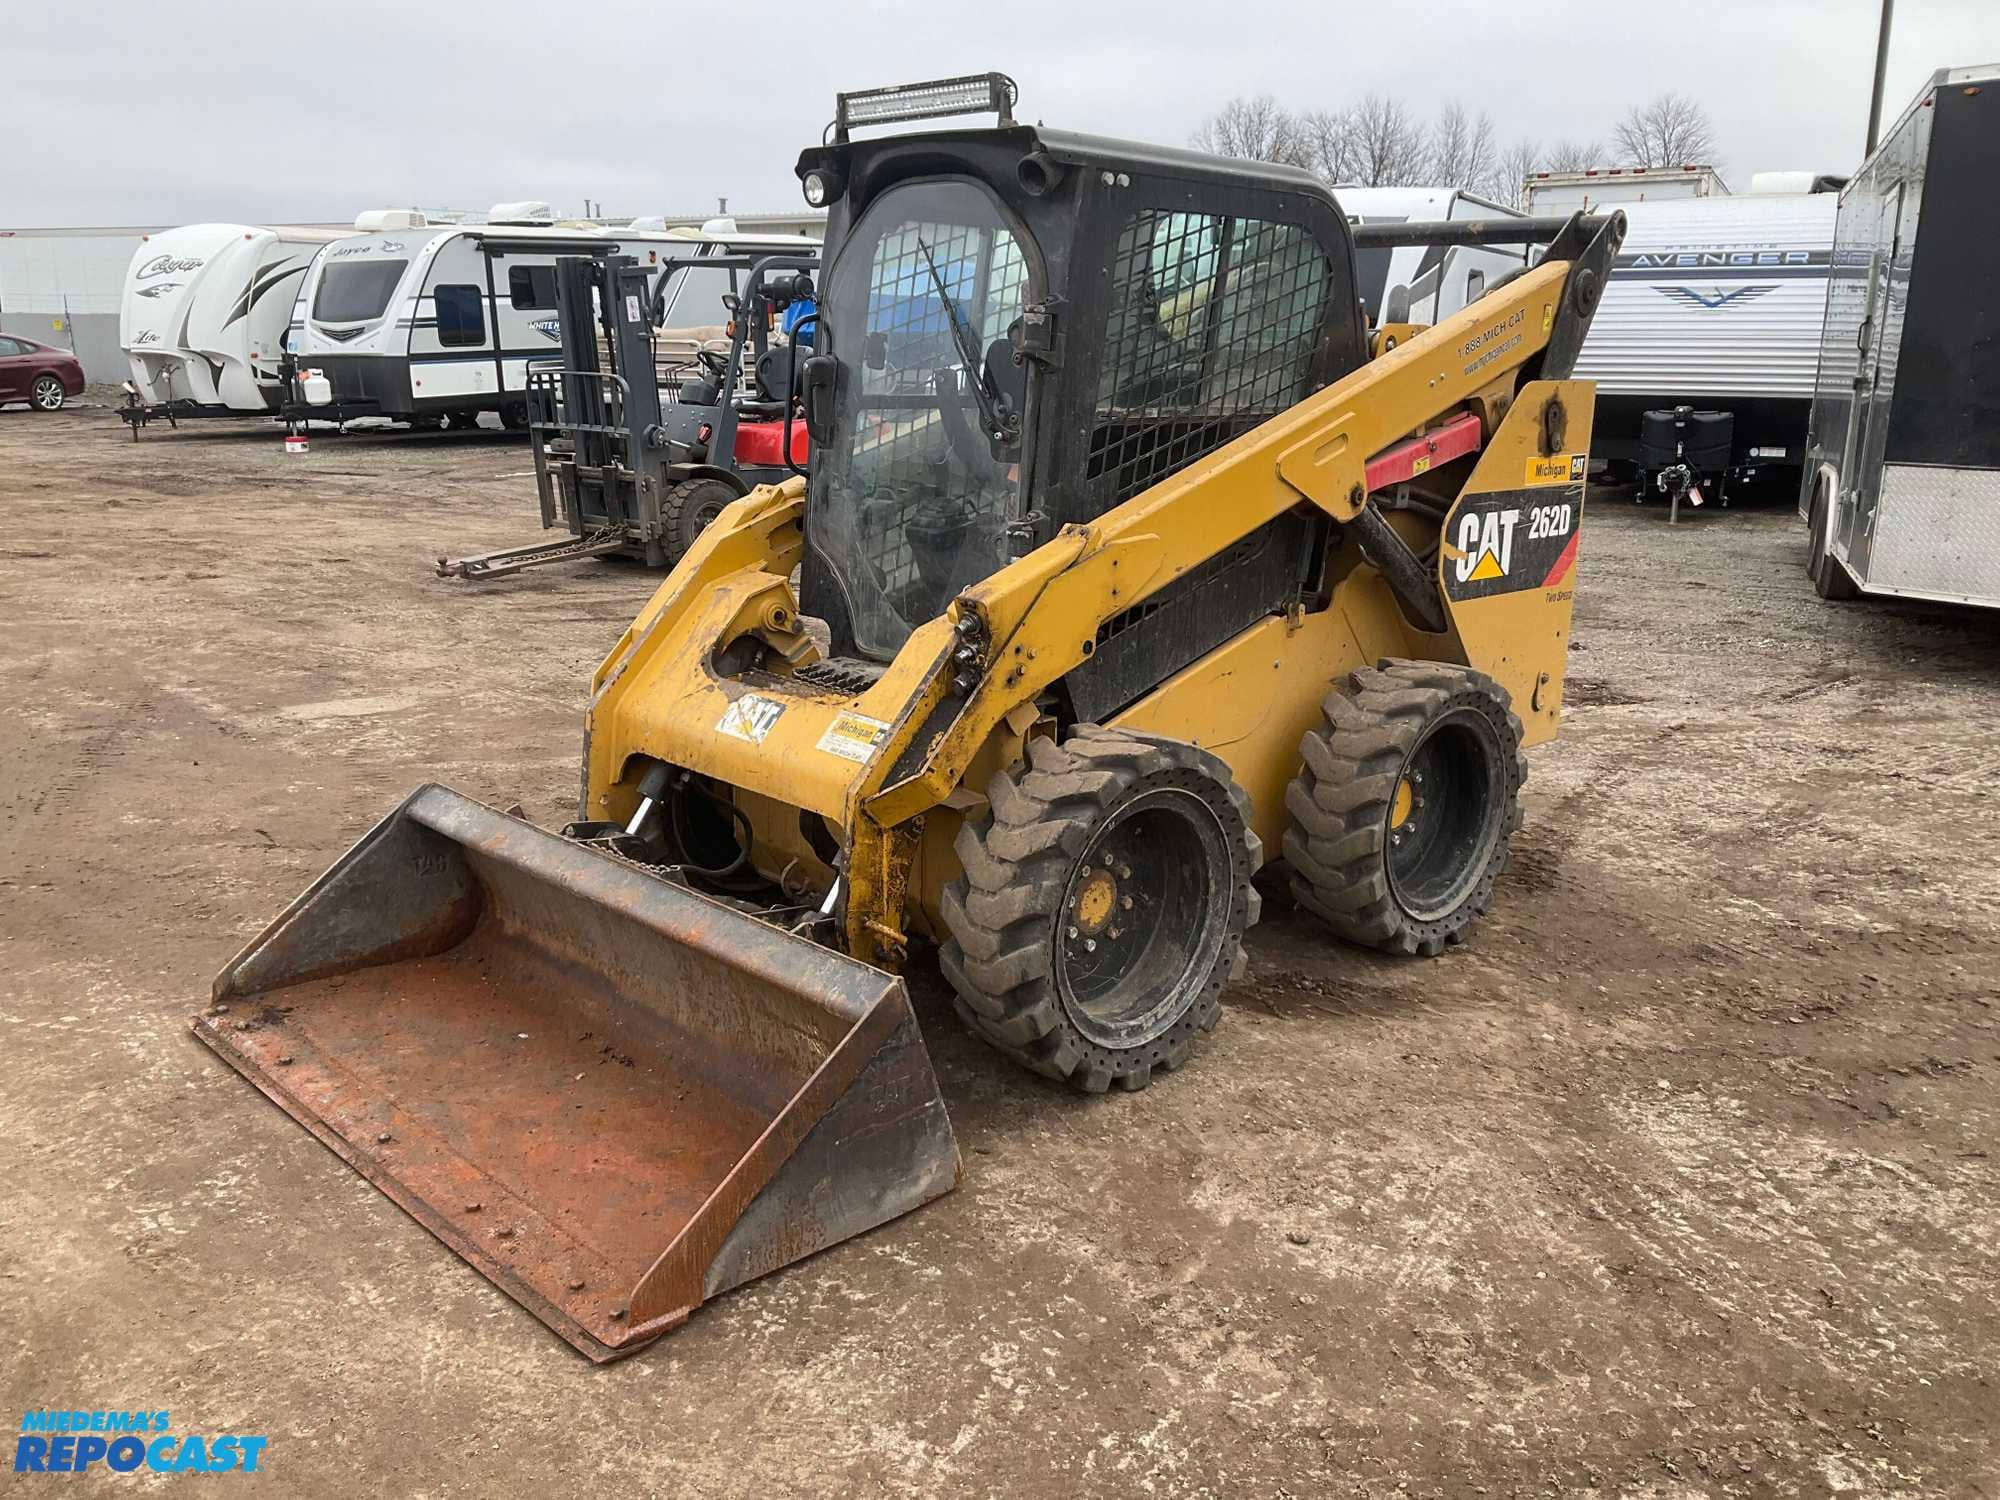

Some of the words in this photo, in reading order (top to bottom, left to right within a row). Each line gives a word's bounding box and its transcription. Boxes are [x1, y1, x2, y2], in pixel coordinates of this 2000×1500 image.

[136, 254, 204, 279] Cougar
[1631, 251, 1809, 267] AVENGER
[528, 321, 553, 330] WHITE
[1535, 463, 1566, 477] Michigan
[1571, 458, 1585, 473] CAT
[1528, 504, 1571, 539] 262D
[1455, 509, 1520, 583] CAT
[838, 720, 873, 737] Michigan
